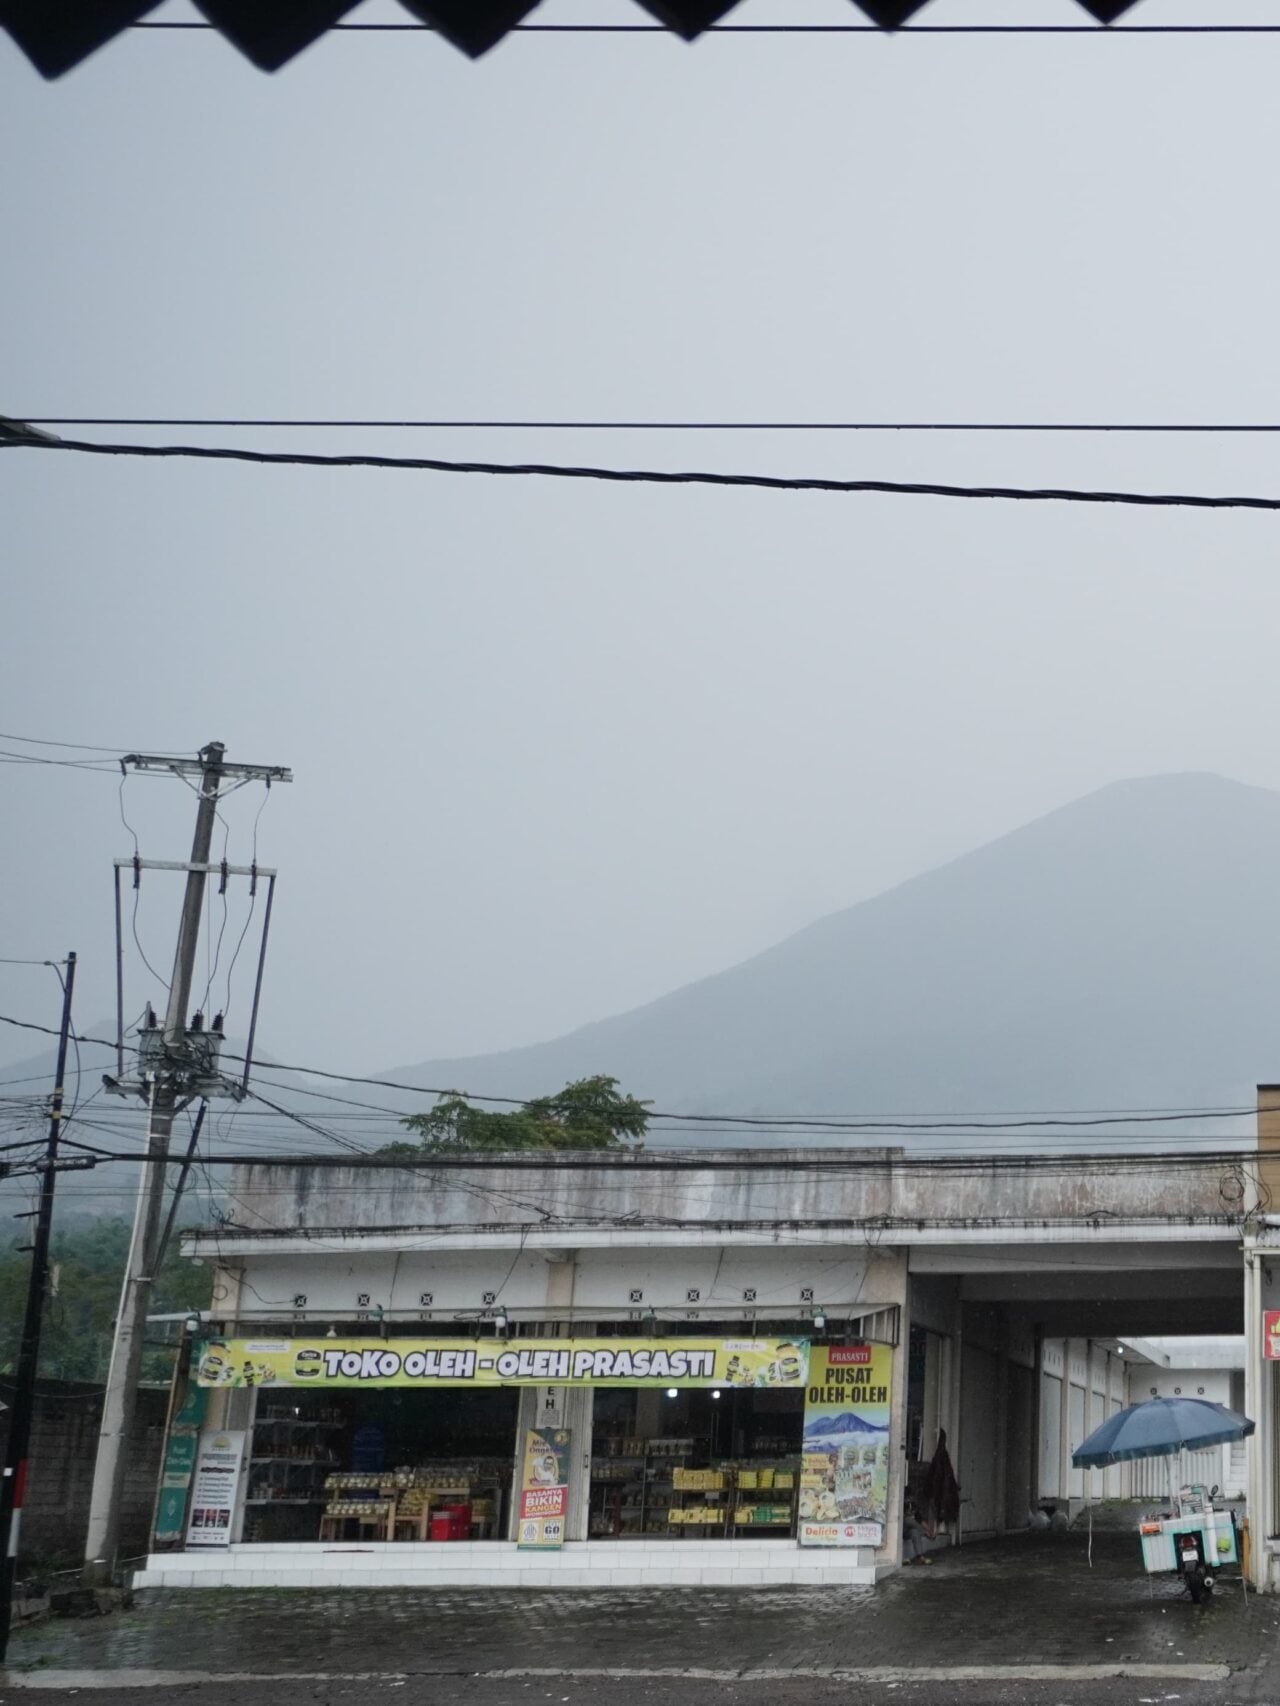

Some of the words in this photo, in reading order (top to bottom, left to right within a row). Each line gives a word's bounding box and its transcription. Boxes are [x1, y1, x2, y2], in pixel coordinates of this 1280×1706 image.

[831, 1352, 869, 1362] PRASASTI
[323, 1349, 401, 1379] TOKO
[402, 1349, 477, 1378] OLEH
[497, 1350, 569, 1378] OLEH
[572, 1349, 716, 1378] PRASASTI
[825, 1367, 873, 1385] PUSAT
[808, 1386, 888, 1404] OLEH-OLEH
[526, 1489, 562, 1498] RASANYA
[525, 1495, 562, 1506] BIKIN
[525, 1504, 561, 1513] KANGEN
